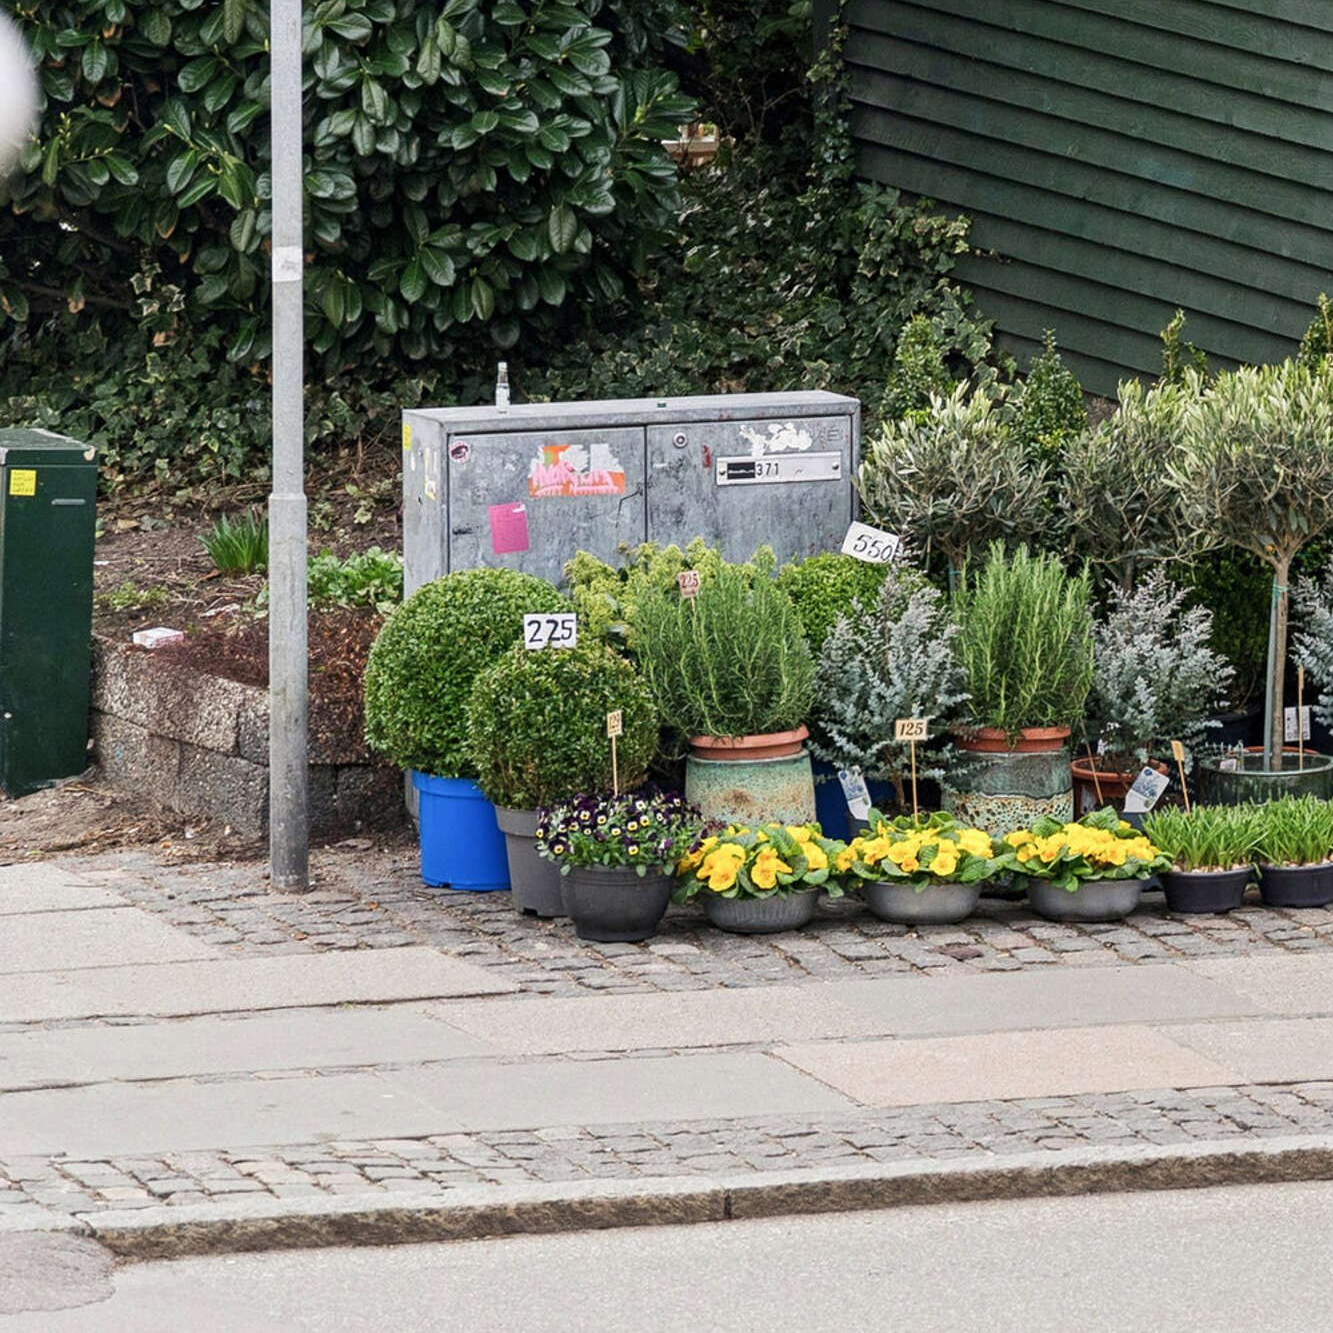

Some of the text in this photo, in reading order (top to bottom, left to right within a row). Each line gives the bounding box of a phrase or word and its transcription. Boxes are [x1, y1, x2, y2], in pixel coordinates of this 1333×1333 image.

[757, 463, 780, 477] 371
[854, 534, 894, 562] 550
[527, 618, 576, 644] 225
[900, 722, 923, 736] 125
